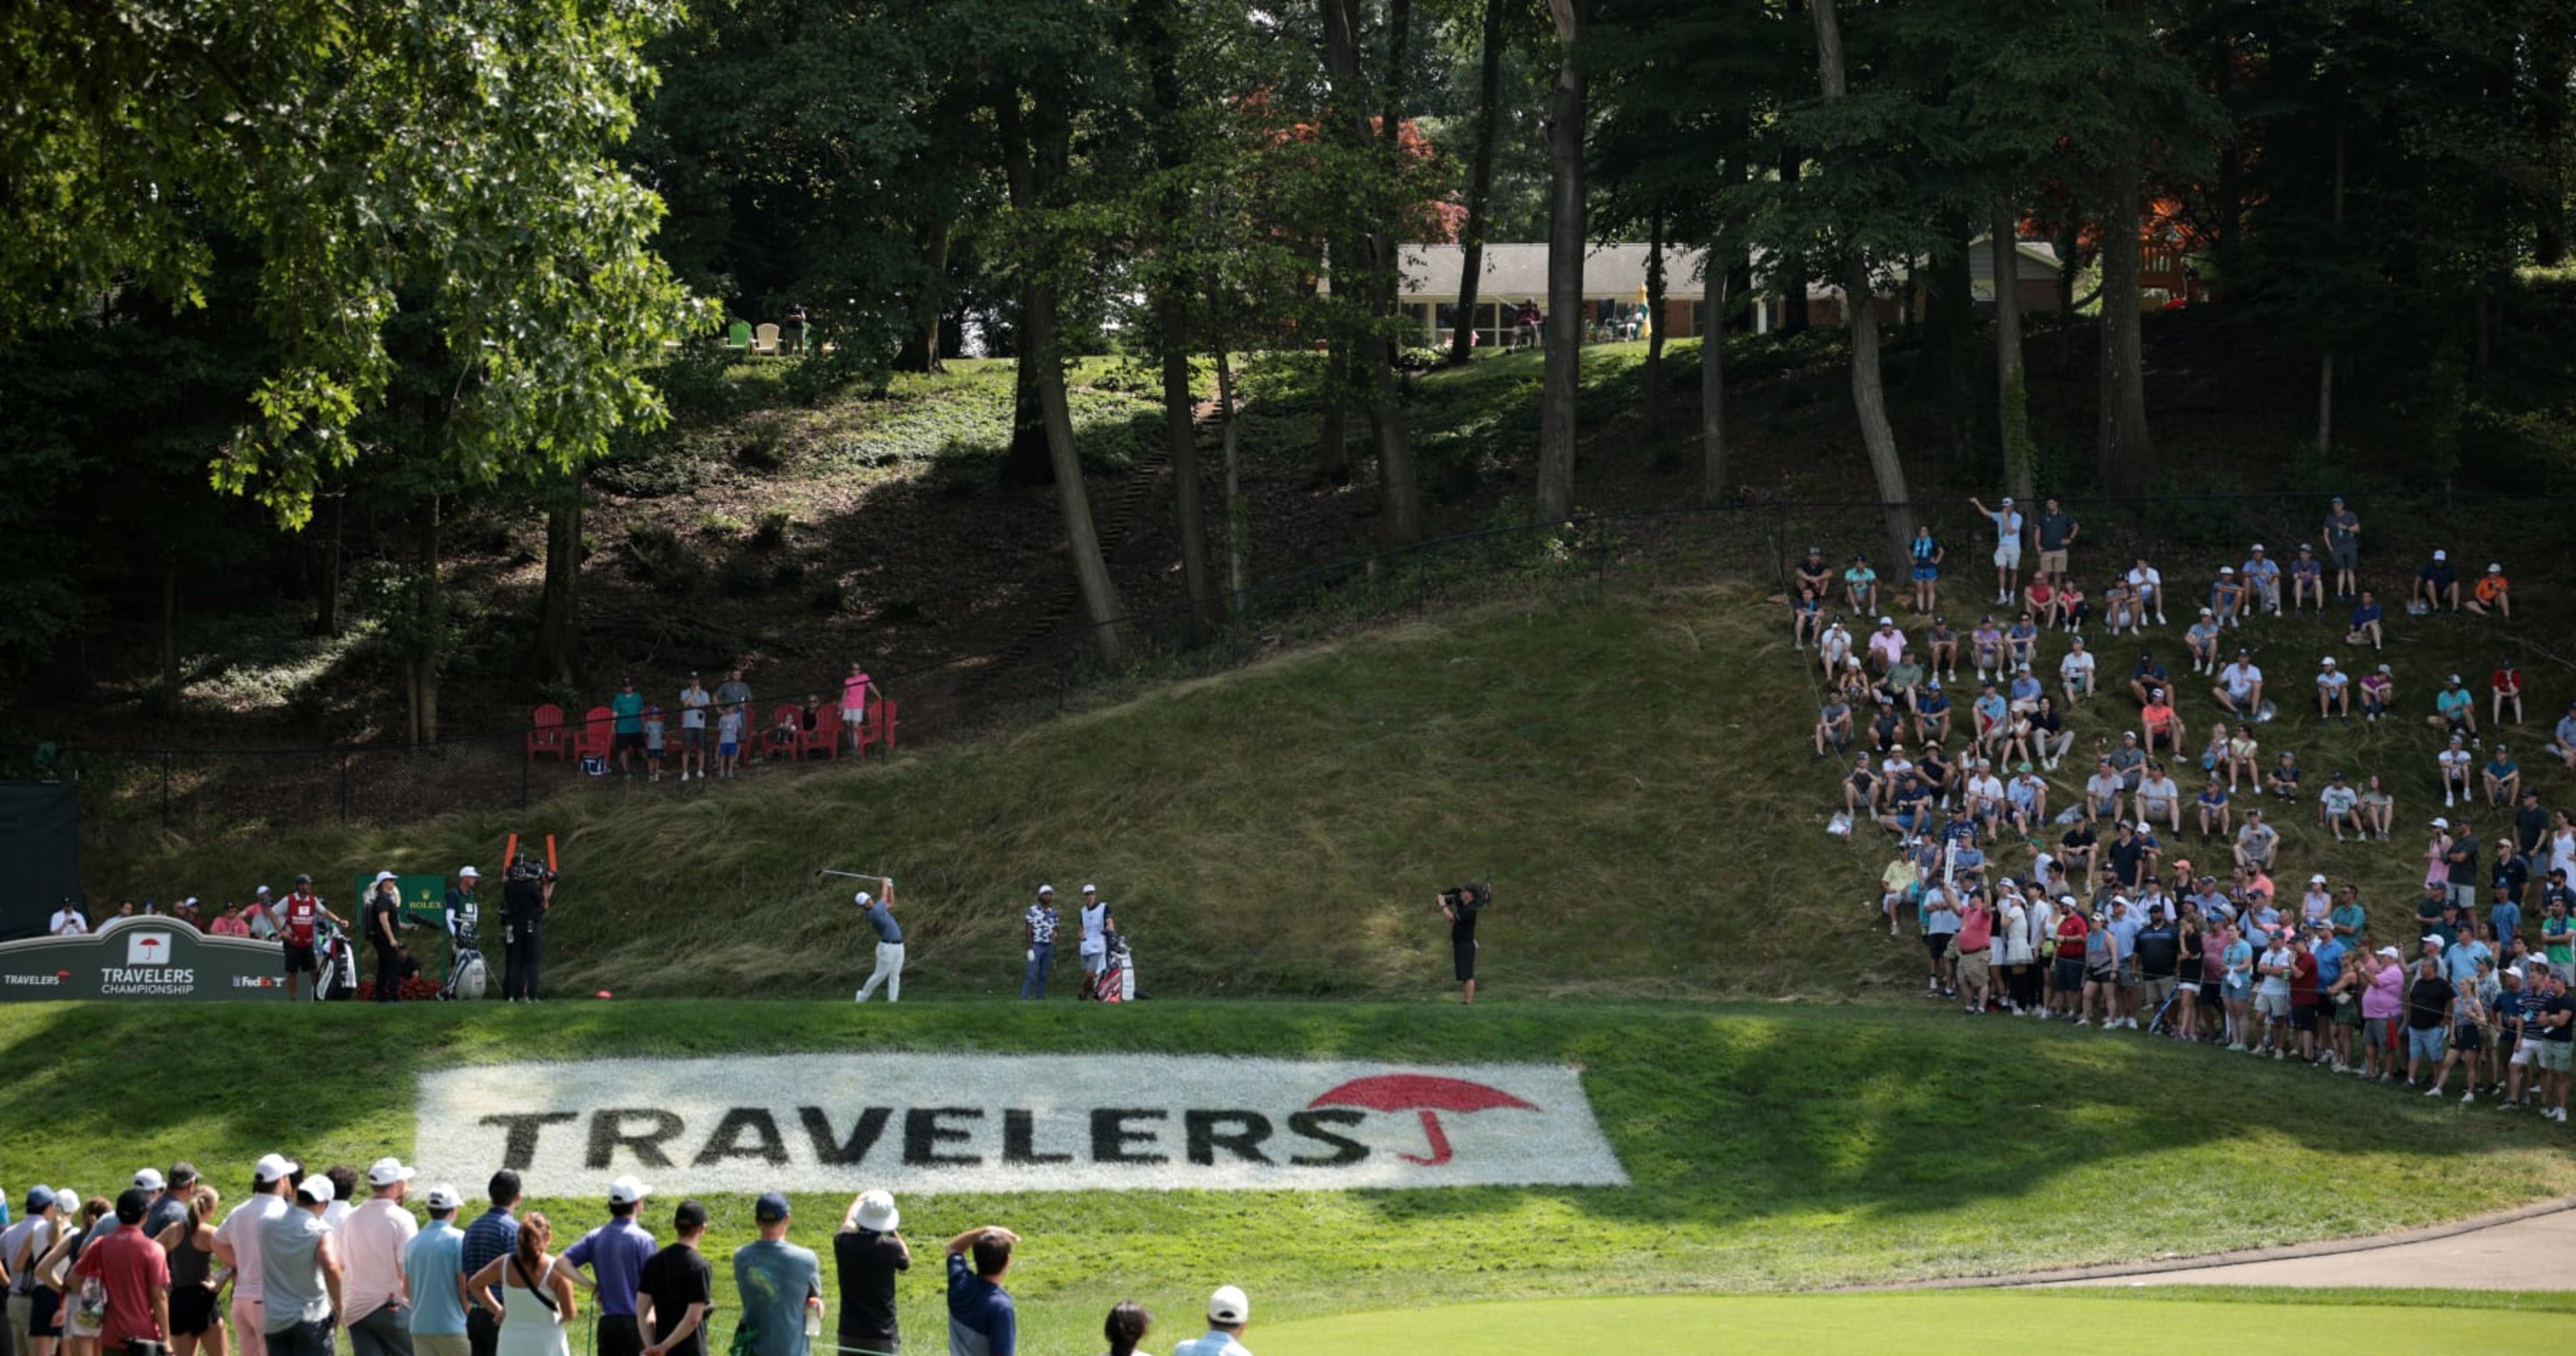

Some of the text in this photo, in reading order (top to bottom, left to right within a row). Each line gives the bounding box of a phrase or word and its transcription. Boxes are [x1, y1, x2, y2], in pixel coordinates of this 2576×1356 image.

[4, 974, 60, 985] TRAVELERS
[101, 968, 194, 983] TRAVELERS
[101, 984, 194, 994] CHAMPIONSHIP
[479, 1107, 1371, 1170] TRAVELERS
